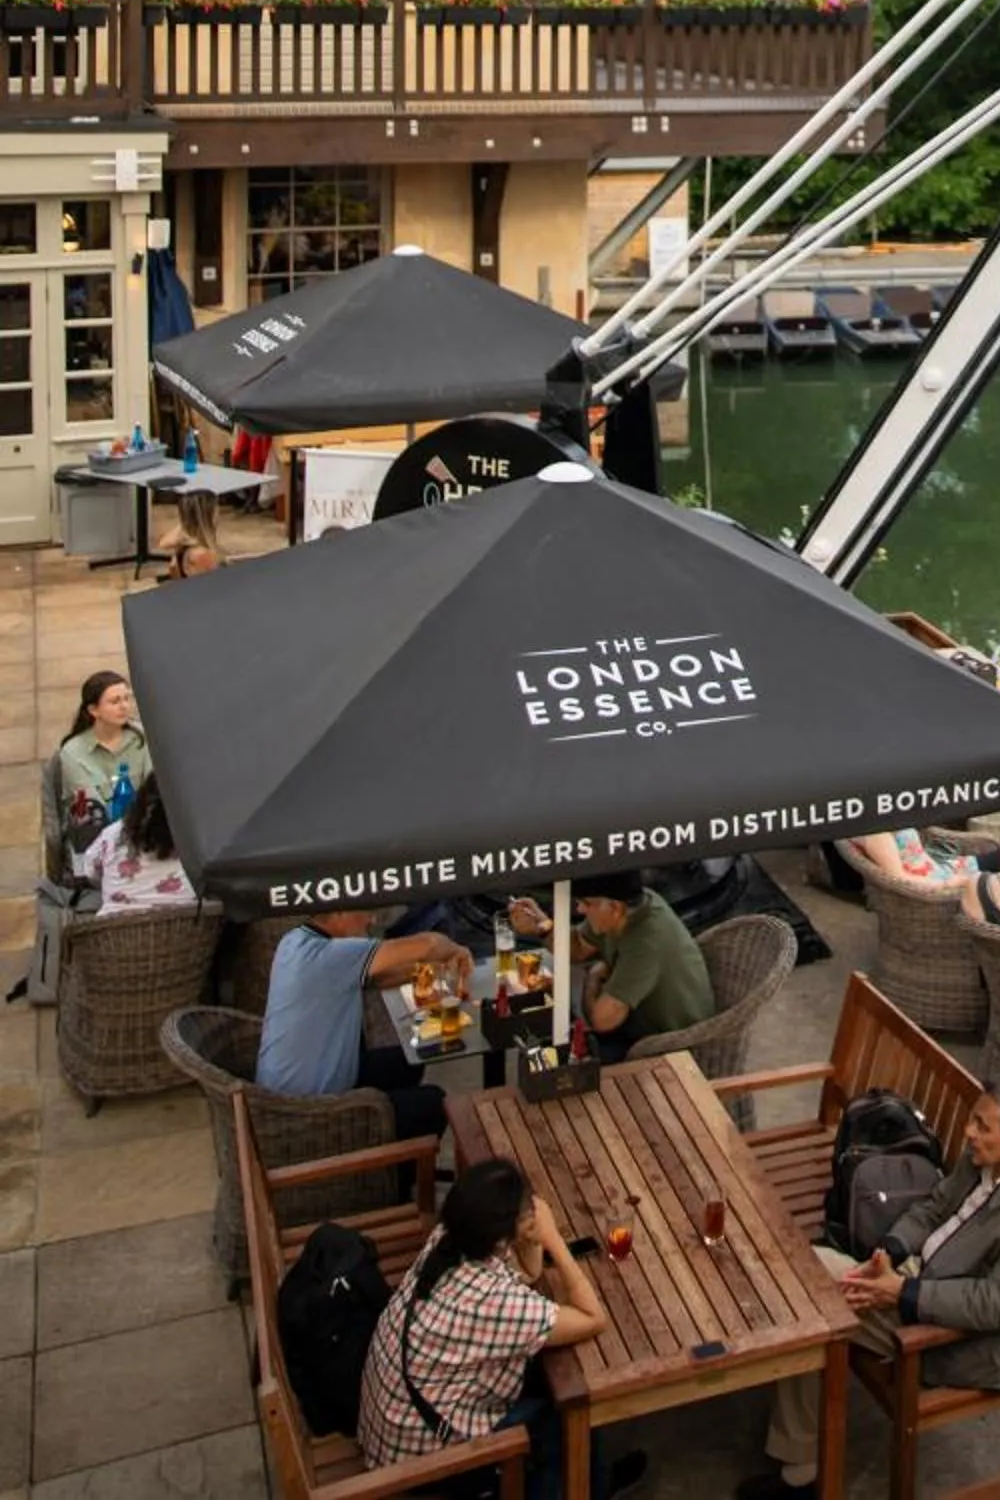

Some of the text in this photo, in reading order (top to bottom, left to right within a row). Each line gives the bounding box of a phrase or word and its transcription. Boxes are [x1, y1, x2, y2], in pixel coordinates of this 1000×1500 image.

[467, 454, 510, 478] THE
[596, 636, 648, 655] THE
[516, 647, 745, 695] LONDON
[525, 677, 757, 726] ESSENCE
[269, 858, 457, 907] EXQUISITE
[471, 837, 594, 878] MIXERS
[607, 821, 696, 856] FROM
[709, 797, 865, 842] DISTILLED
